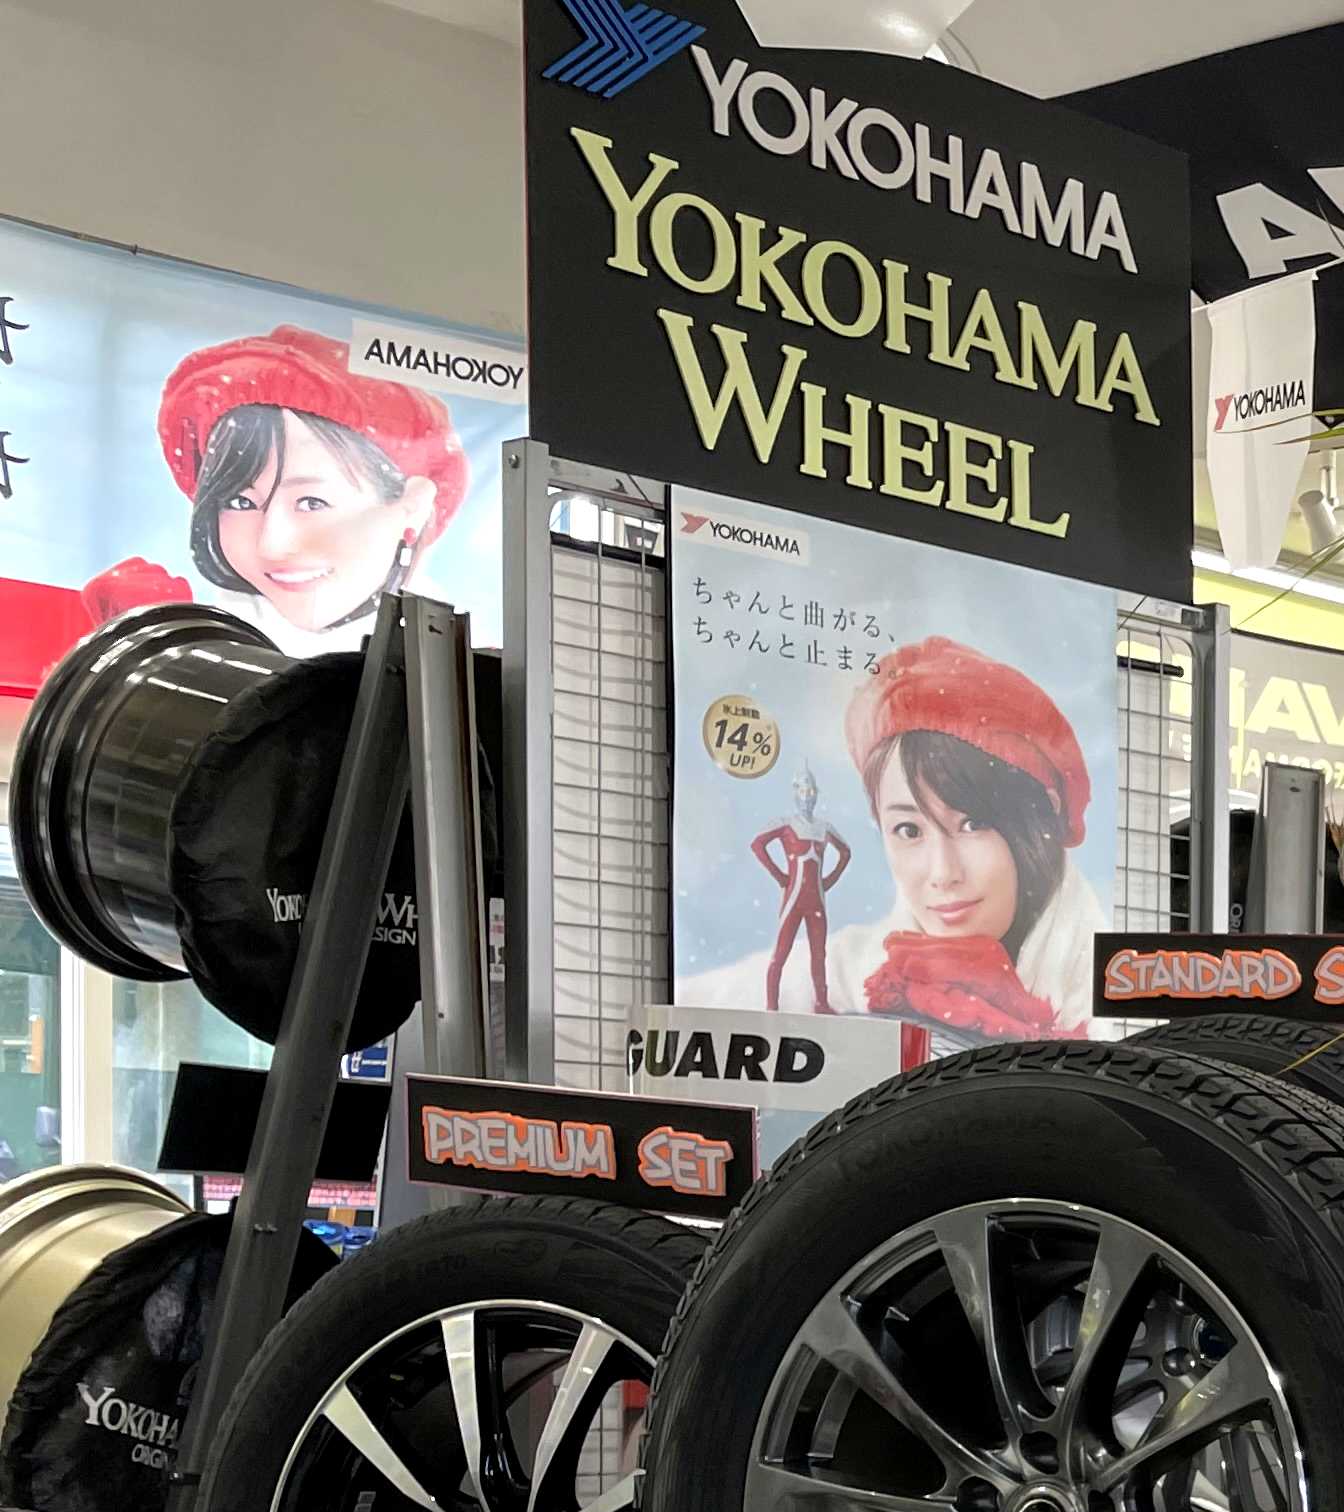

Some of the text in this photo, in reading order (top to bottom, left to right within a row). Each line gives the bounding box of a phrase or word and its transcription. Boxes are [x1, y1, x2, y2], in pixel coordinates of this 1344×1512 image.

[691, 44, 1139, 275] YOKOHAMA
[570, 127, 1161, 427] YOKOHAMA
[659, 308, 1072, 538] WHEEL
[1233, 380, 1306, 422] YOKOHAMA
[709, 520, 801, 556] YOKOHAMA
[692, 577, 898, 643] ちゃんと曲がる、
[692, 615, 900, 680] ちゃんと止まる。
[712, 718, 774, 758] 14%
[729, 753, 757, 770] UP!
[1104, 948, 1301, 1001] STANDARD
[422, 1105, 734, 1197] PREMIUM SET
[76, 1382, 180, 1448] YOKOHA
